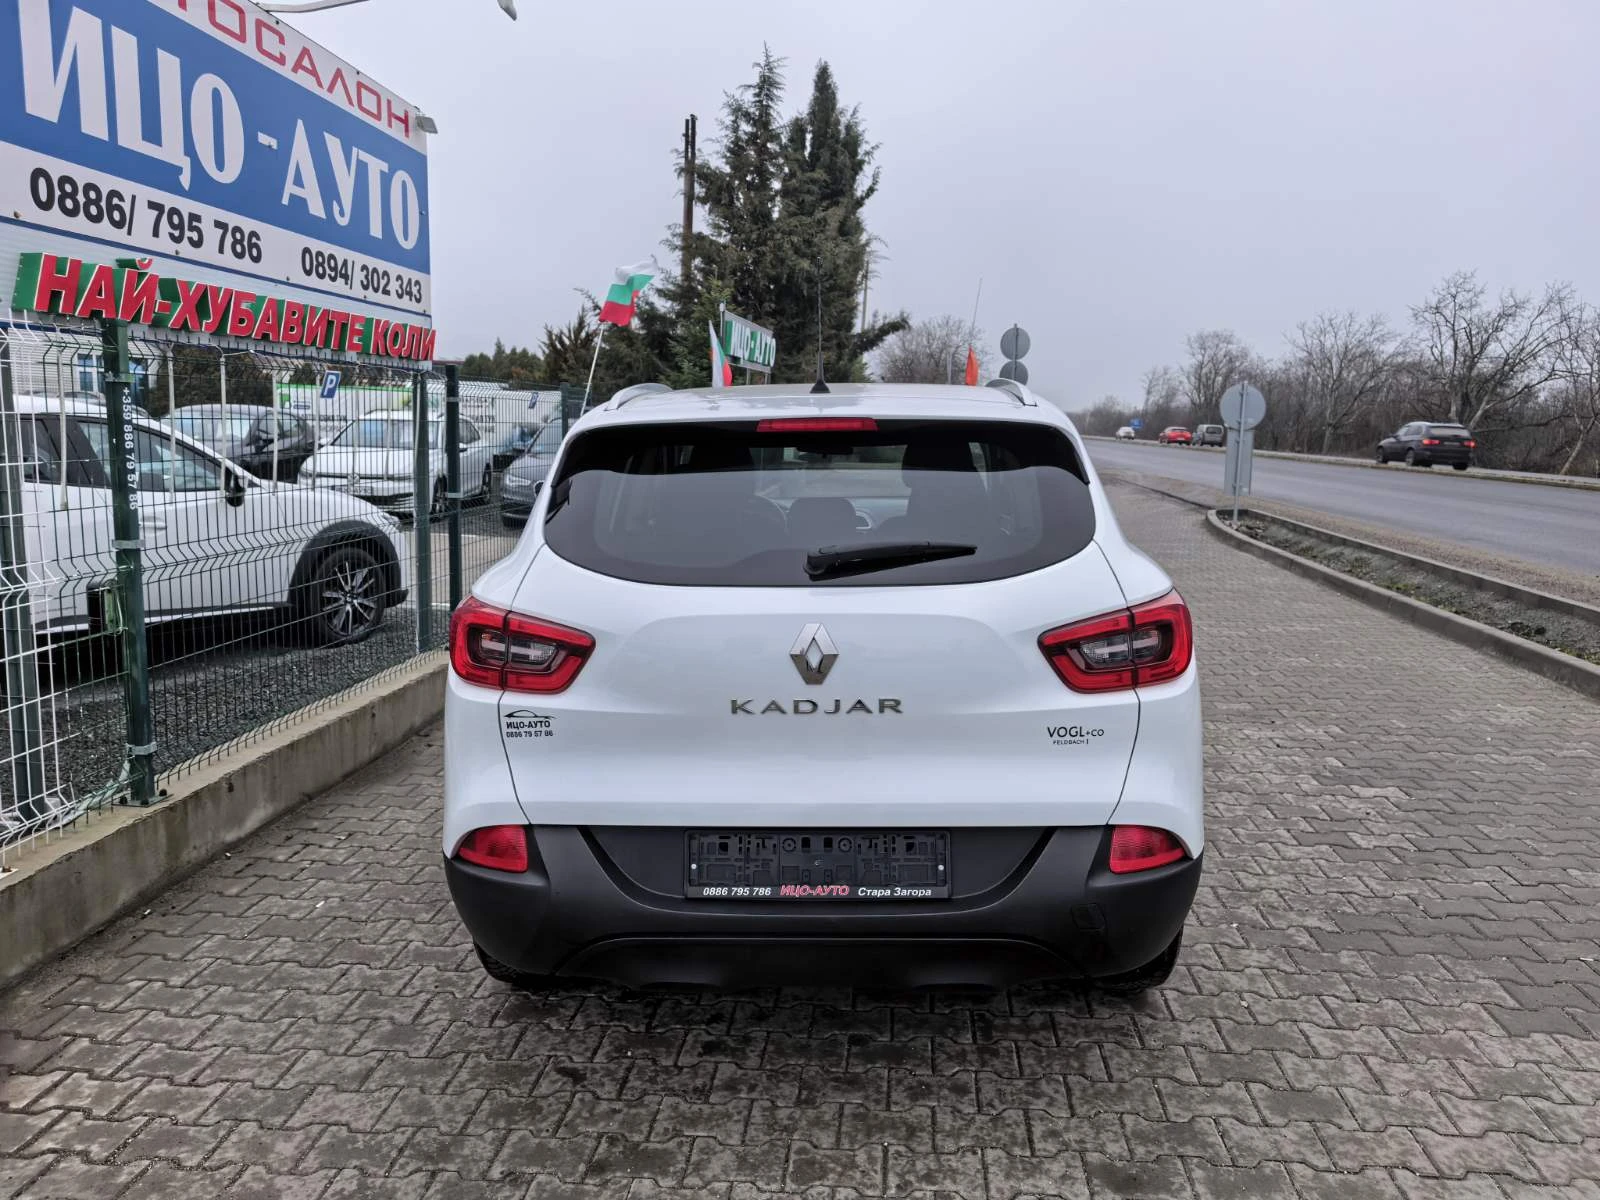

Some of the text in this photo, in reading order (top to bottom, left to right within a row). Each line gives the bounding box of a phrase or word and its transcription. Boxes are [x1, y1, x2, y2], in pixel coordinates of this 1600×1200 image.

[30, 168, 423, 304] 0886/ 795 786 0894/ 302 343
[33, 252, 437, 361] НАЙ-ХУБАВИТЕ КОЛИ
[122, 387, 139, 510] +359 886 79 57 86
[506, 720, 551, 730] ИЦО-АУТО
[730, 697, 904, 715] KADJAR
[703, 884, 932, 898] 0886 795 786 ИЦО-АУТО Стара Загора
